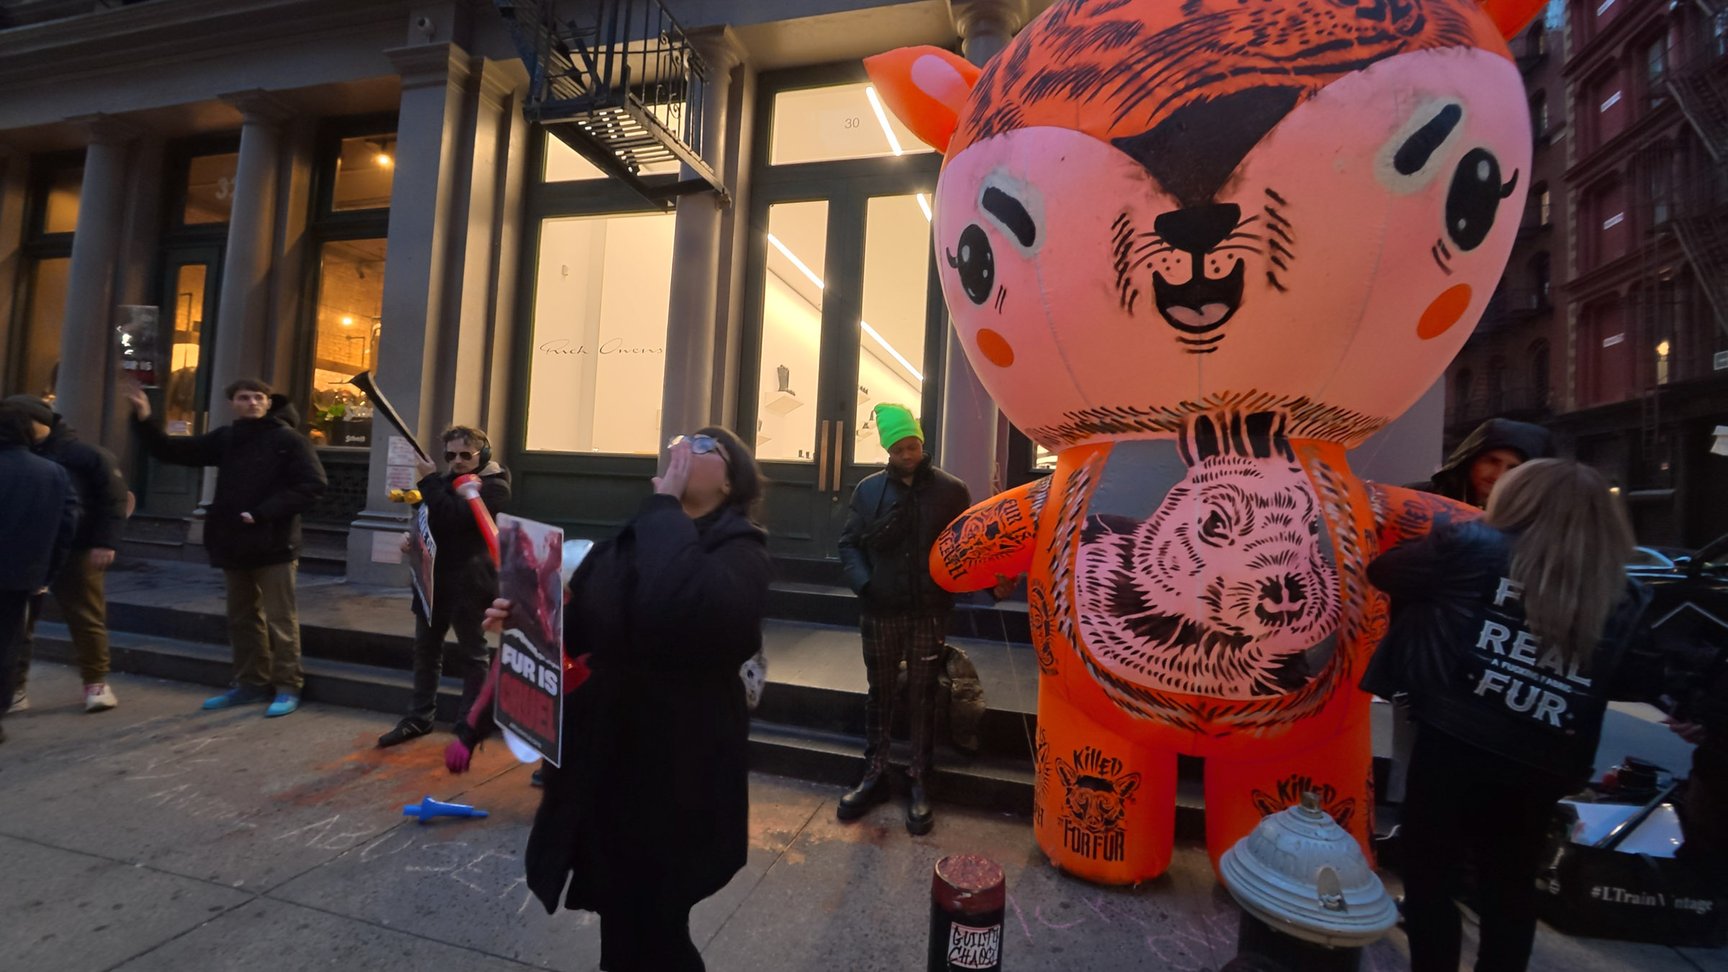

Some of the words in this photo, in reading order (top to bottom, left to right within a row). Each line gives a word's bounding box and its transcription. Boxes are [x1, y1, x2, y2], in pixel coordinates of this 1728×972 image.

[844, 117, 860, 129] 30
[599, 337, 663, 355] Owens
[501, 642, 536, 683] FUR
[538, 664, 558, 696] IS
[1475, 619, 1592, 687] REAL
[1473, 668, 1569, 728] FUR
[1062, 817, 1090, 858] FOR
[1092, 828, 1125, 862] FUR
